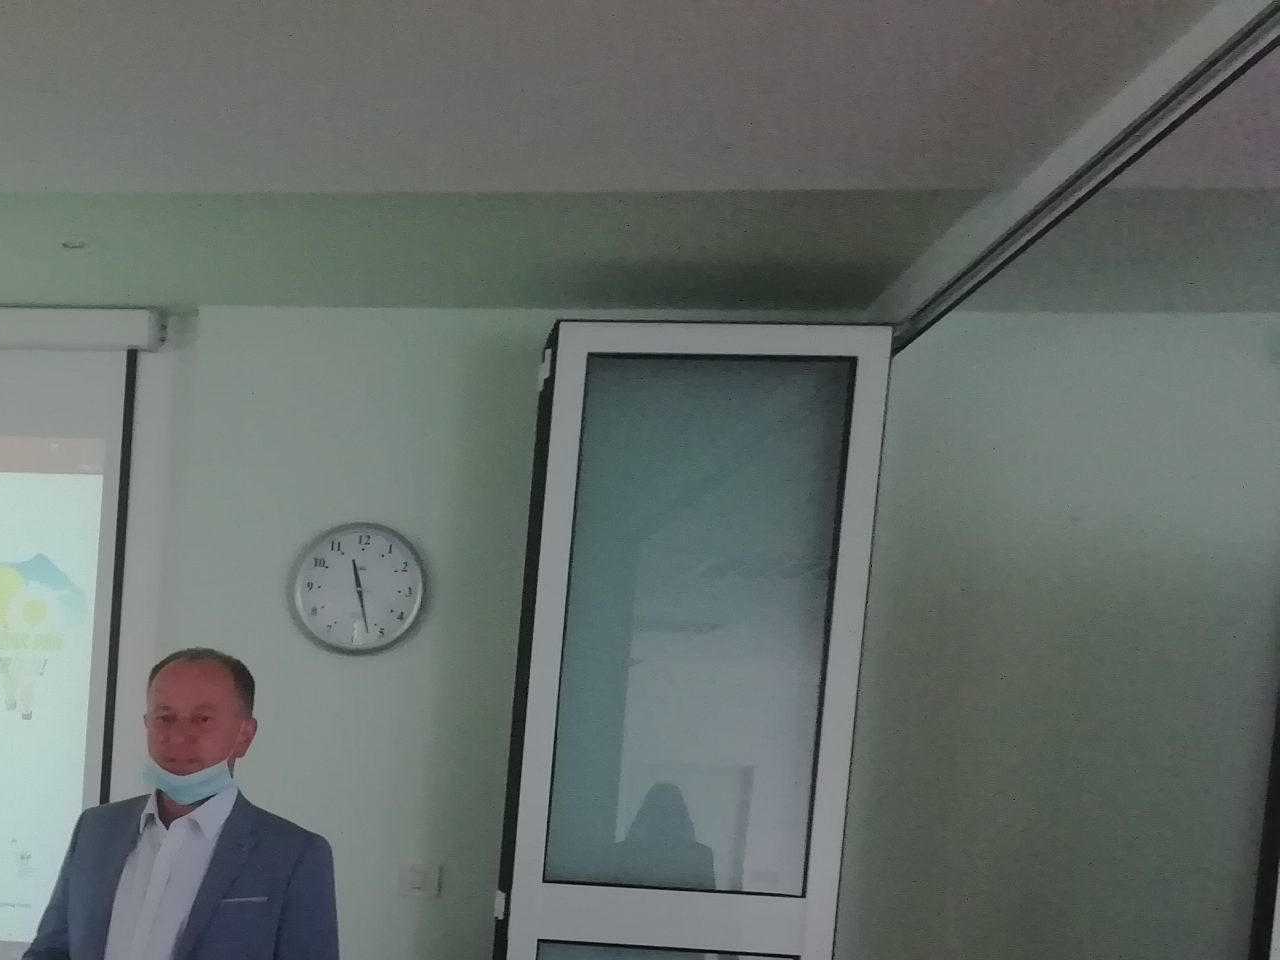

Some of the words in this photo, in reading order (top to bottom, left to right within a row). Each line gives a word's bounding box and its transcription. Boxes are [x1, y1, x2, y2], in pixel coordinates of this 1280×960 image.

[358, 535, 371, 545] 12
[330, 540, 341, 551] 11
[388, 544, 393, 554] 1
[313, 557, 325, 567] 10
[401, 562, 408, 572] 2
[306, 581, 313, 592] 9
